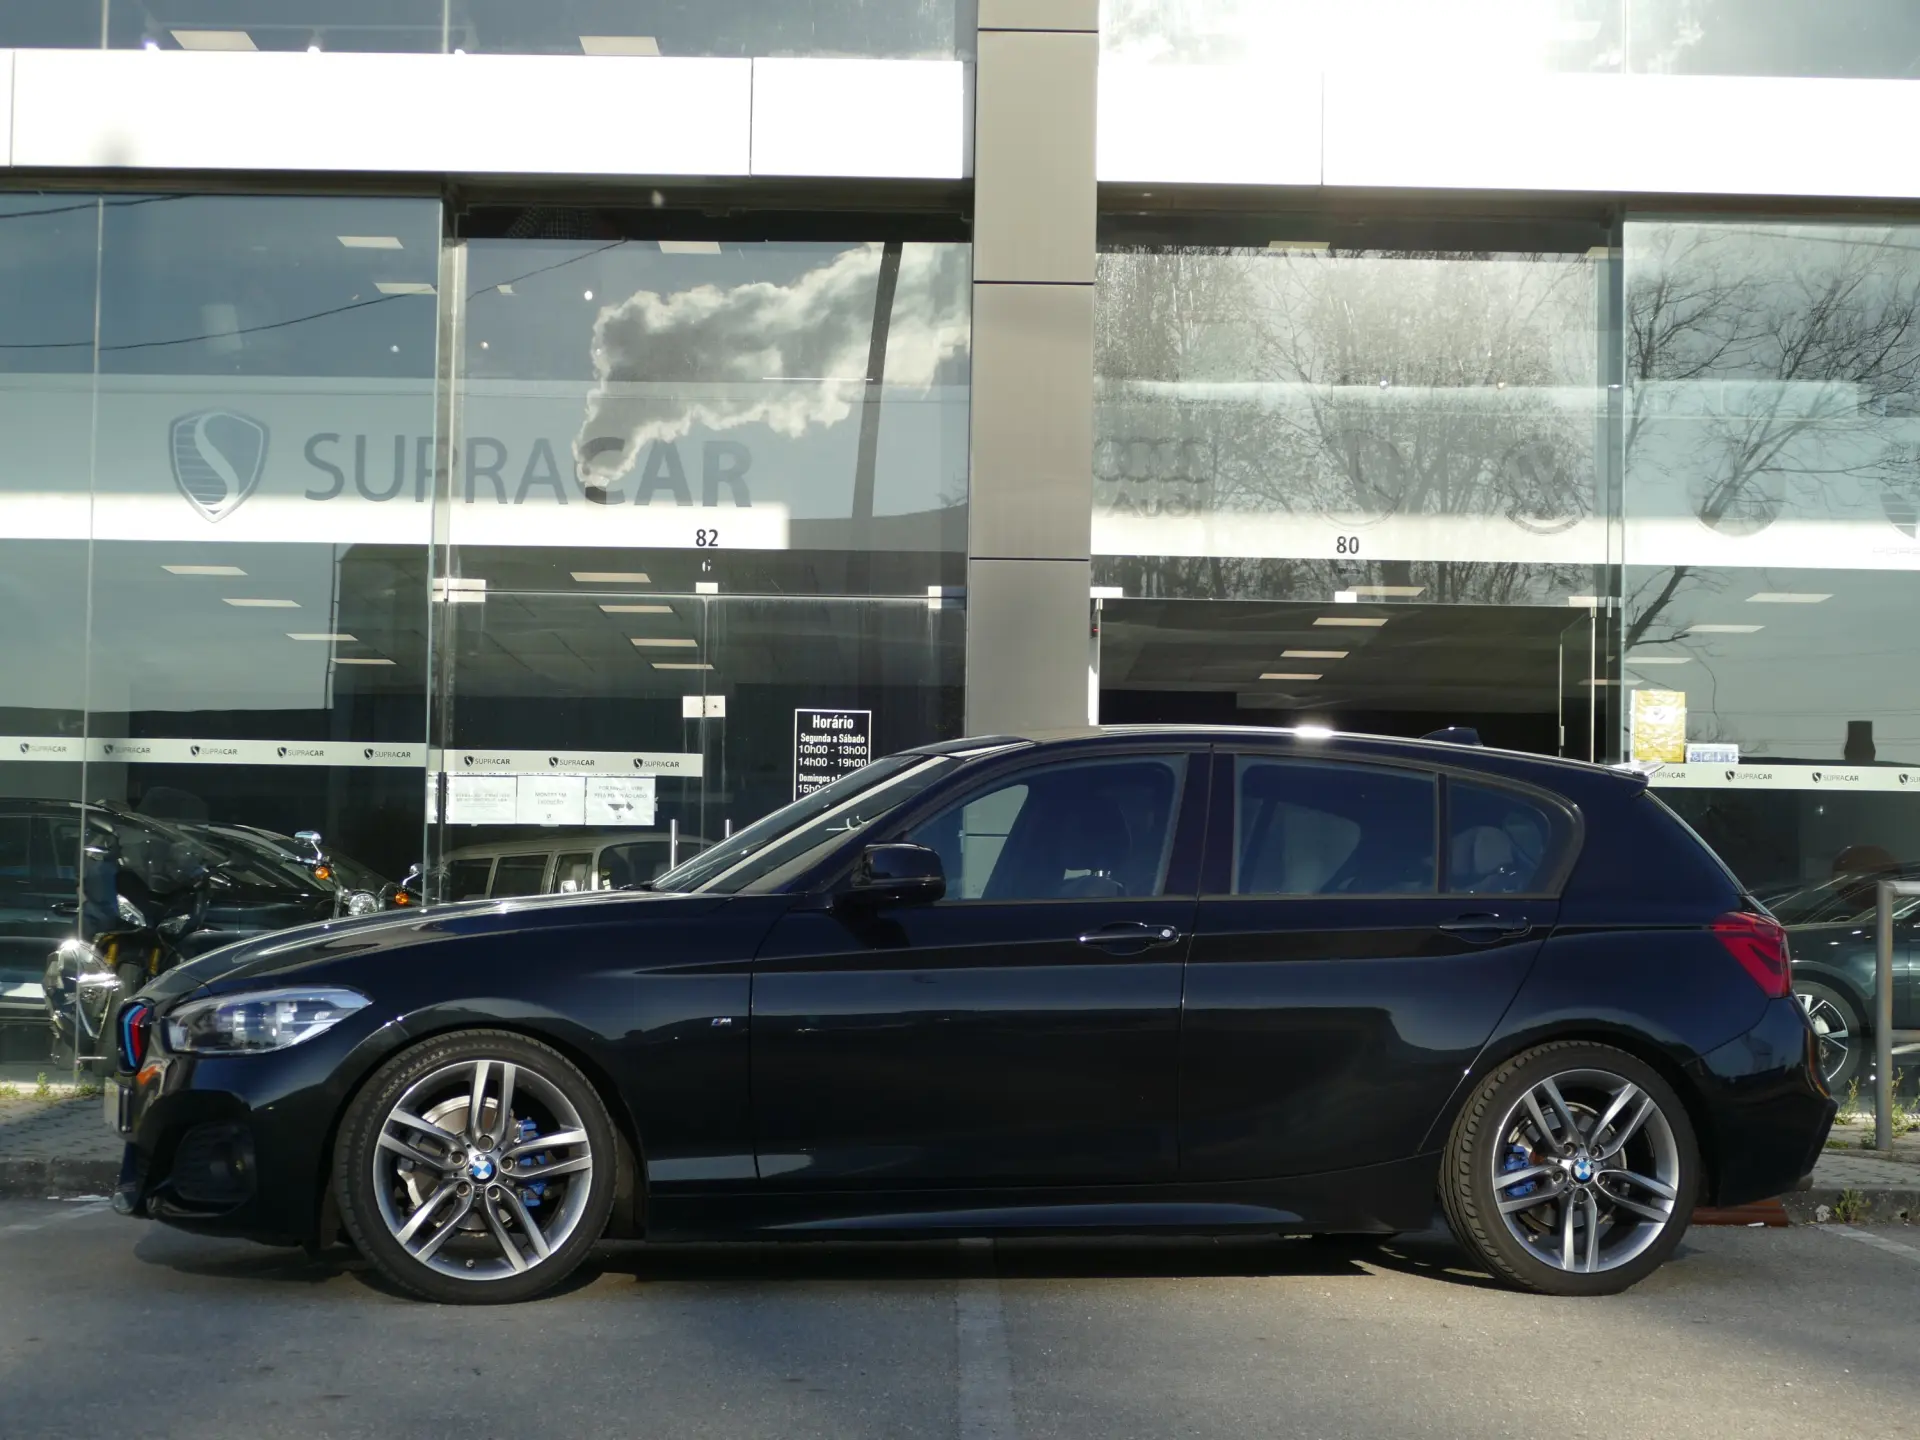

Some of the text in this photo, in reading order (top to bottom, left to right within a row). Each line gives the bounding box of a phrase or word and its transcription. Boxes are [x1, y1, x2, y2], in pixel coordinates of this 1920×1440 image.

[696, 528, 719, 547] 82
[1336, 535, 1360, 554] 80
[812, 714, 854, 729] Horário
[800, 733, 865, 744] Segunda a Sábado
[287, 749, 324, 757] SUPRACAR
[374, 750, 411, 758] SUPRACAR
[798, 744, 828, 754] 10h00
[837, 745, 867, 755] 13h00
[474, 757, 511, 766] SUPRACAR
[559, 758, 595, 767] SUPRACAR
[643, 759, 680, 769] SUPRACAR
[798, 757, 828, 767] 14h00
[837, 758, 867, 768] 19h00
[799, 773, 830, 784] Domingos
[1823, 774, 1860, 782] SUPRACAR
